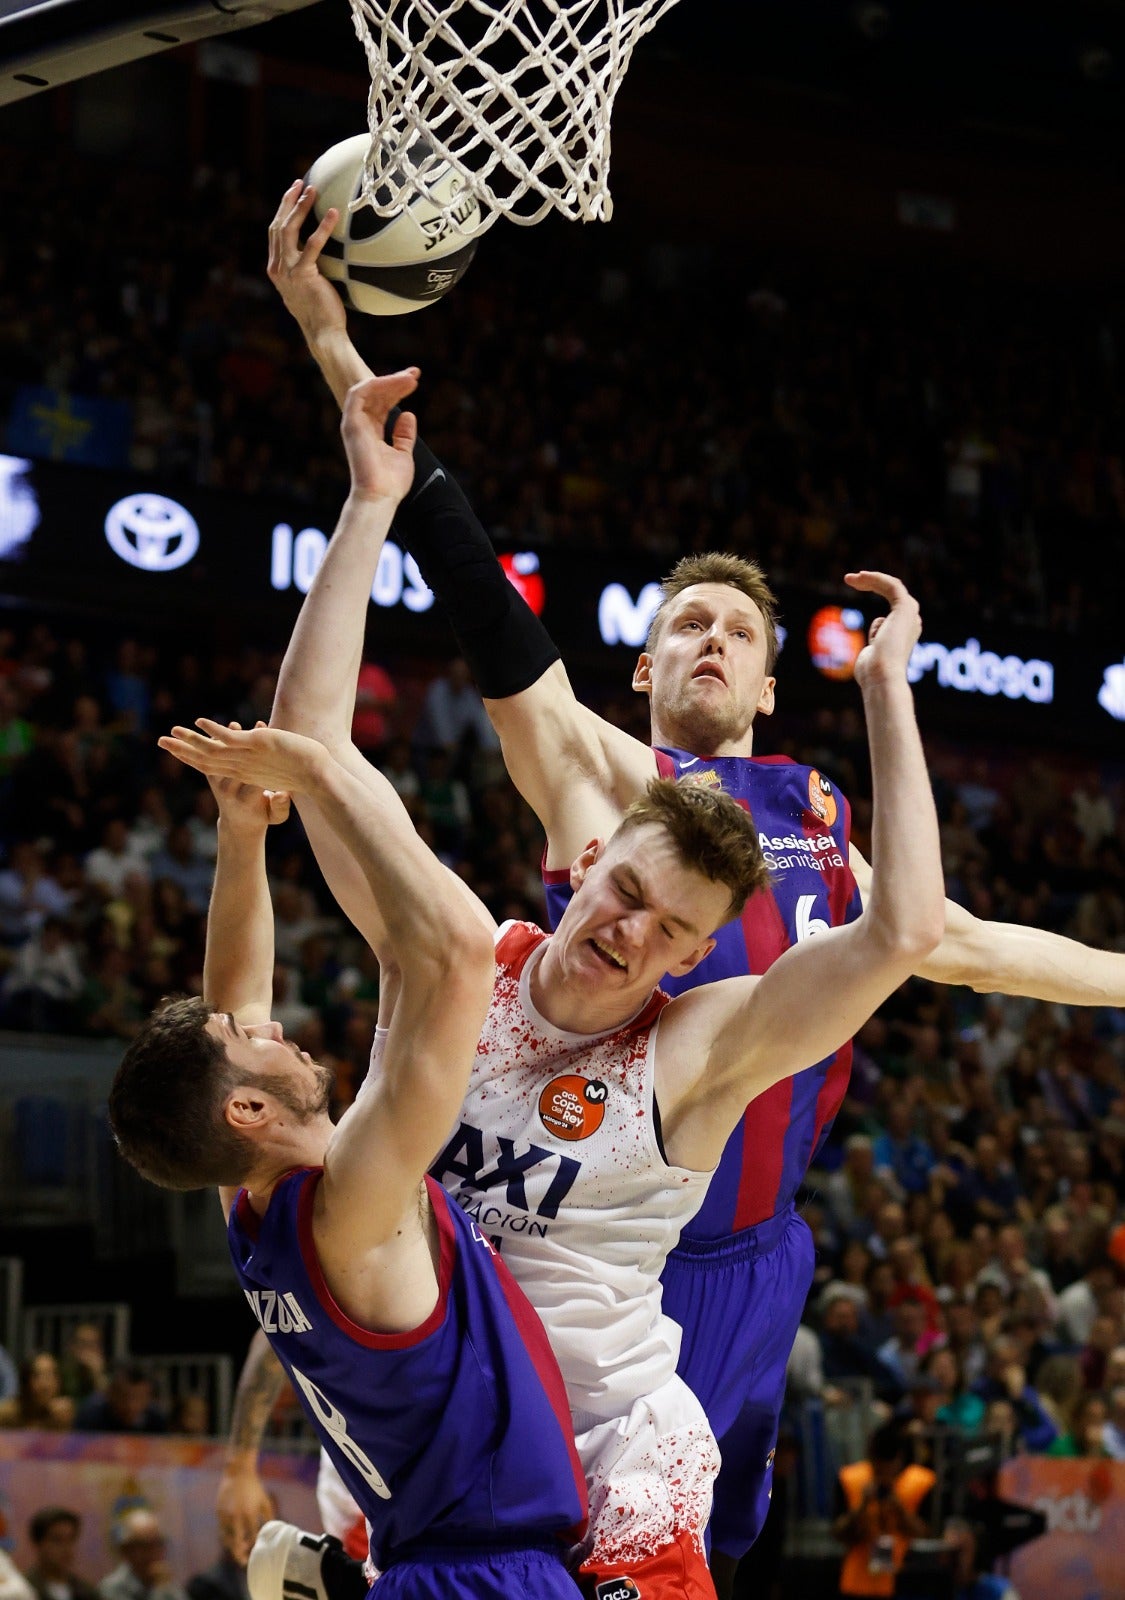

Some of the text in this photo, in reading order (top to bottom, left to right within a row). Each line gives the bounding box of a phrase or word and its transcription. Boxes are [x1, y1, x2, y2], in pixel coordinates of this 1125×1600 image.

[271, 522, 435, 612] IOOS
[762, 851, 845, 871] Sanitària
[552, 1094, 584, 1114] Copa
[561, 1091, 578, 1102] acb
[562, 1110, 584, 1128] Rey
[427, 1122, 582, 1220] AXI
[290, 1364, 392, 1500] 8
